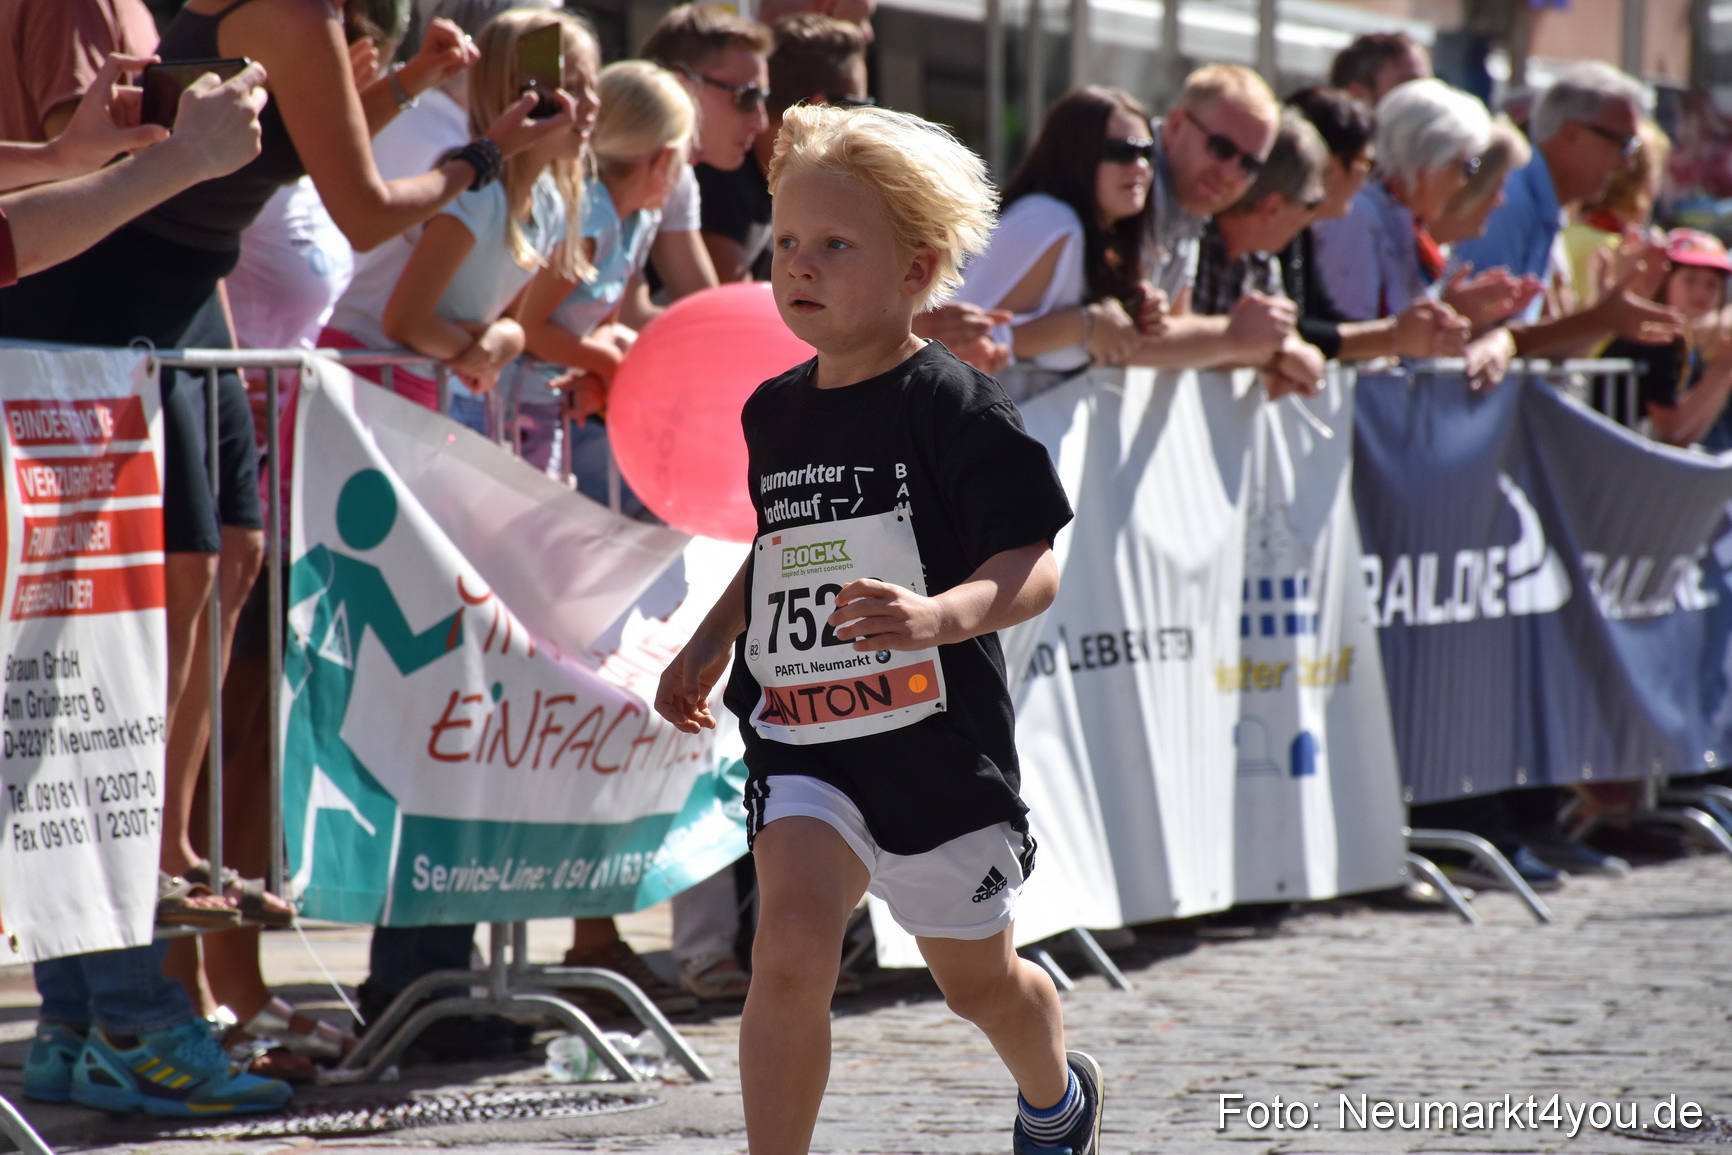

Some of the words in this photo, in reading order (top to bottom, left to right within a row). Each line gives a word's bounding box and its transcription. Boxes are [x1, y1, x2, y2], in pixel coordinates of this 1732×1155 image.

[782, 539, 852, 570] BOCK
[800, 569, 806, 577] by
[806, 566, 823, 575] smart
[823, 563, 854, 573] concepts
[768, 577, 884, 654] 752
[4, 654, 40, 682] Braun
[775, 662, 809, 677] PARTL
[810, 654, 872, 674] Neumarkt
[3, 691, 24, 721] Am
[92, 686, 106, 714] 8
[759, 674, 892, 726] ANTON
[7, 782, 34, 815] Tel.
[35, 780, 80, 811] 09181
[95, 770, 157, 804] 2307-0
[12, 822, 39, 852] Fax
[40, 815, 91, 850] 09181
[972, 876, 1008, 904] adidas
